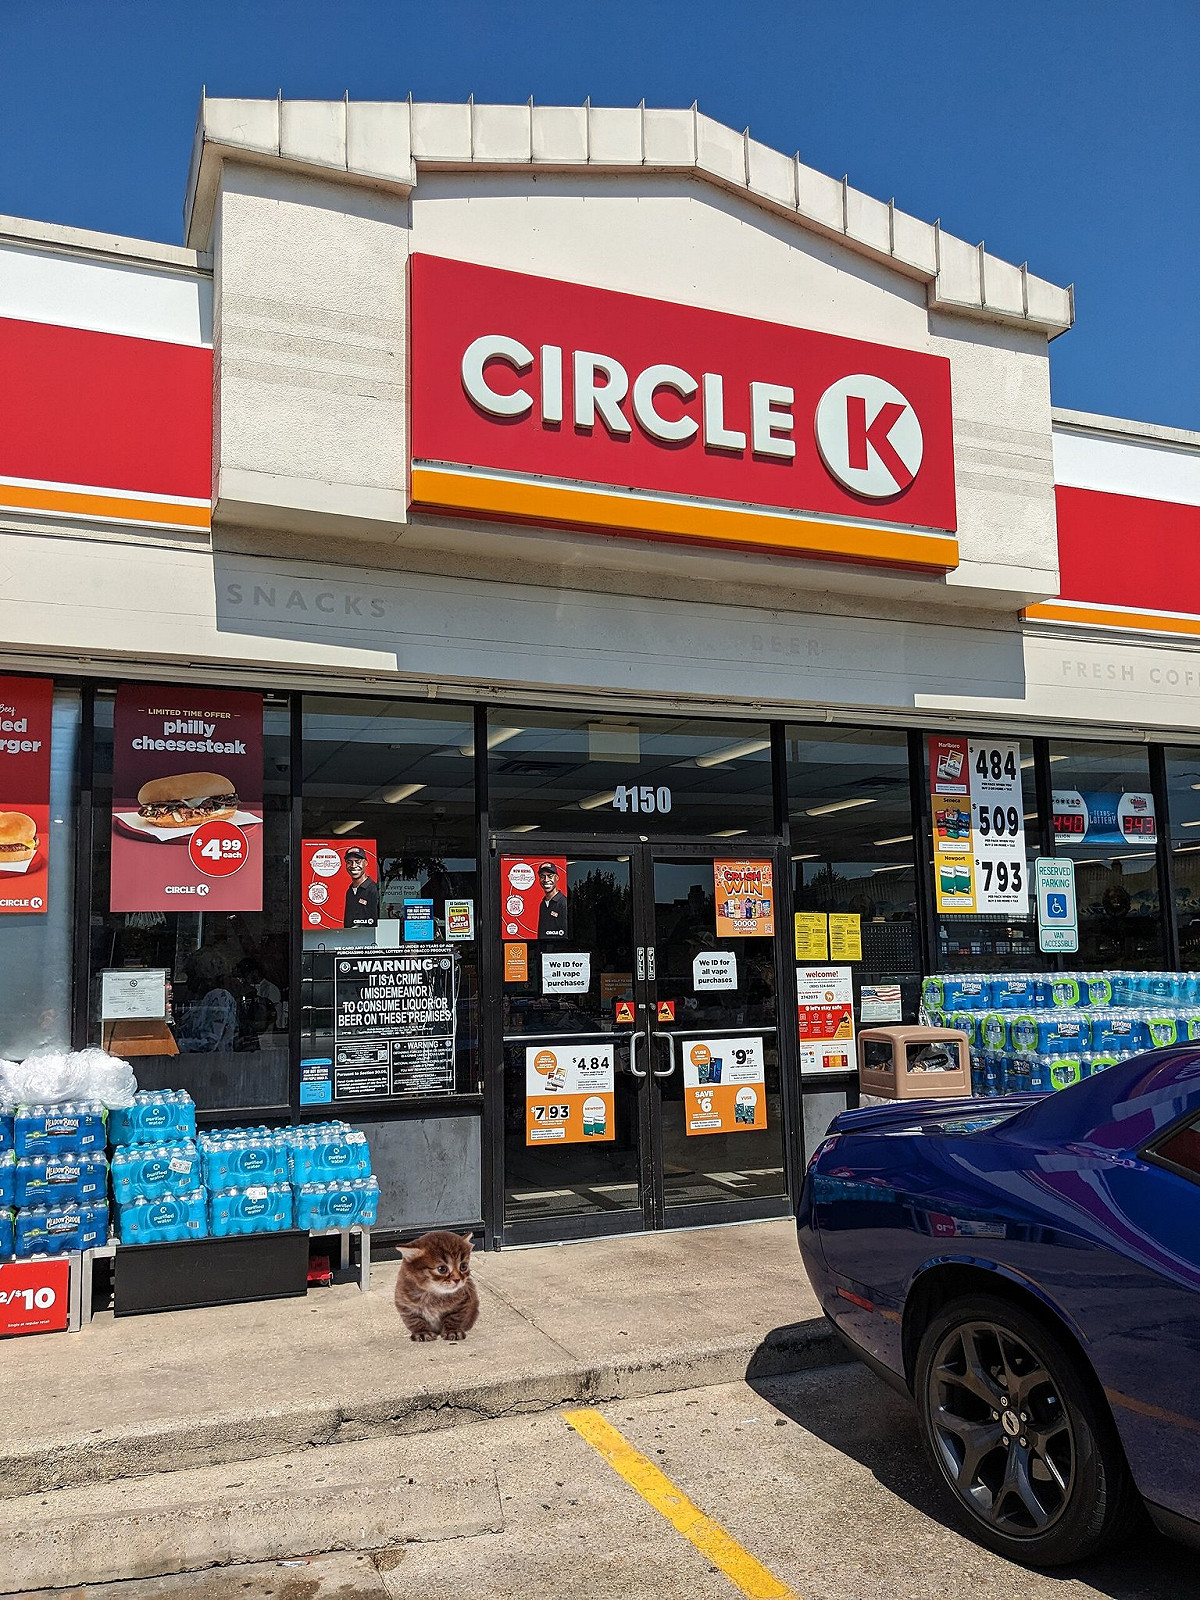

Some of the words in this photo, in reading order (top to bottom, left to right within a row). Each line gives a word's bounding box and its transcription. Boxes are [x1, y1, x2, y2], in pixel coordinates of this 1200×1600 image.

[461, 334, 796, 459] CIRCLE
[845, 395, 915, 492] K
[226, 583, 387, 618] SNACKS
[1061, 660, 1135, 681] FRESH
[148, 708, 182, 716] LIMITED
[182, 709, 203, 718] TIME
[203, 711, 231, 719] OFFER
[163, 719, 216, 738] philly
[131, 735, 247, 755] cheesesteak
[612, 785, 672, 814] 4150
[1089, 815, 1117, 825] LOTTERY
[1124, 817, 1154, 834] 343
[222, 851, 243, 859] each
[723, 870, 762, 881] CRUSH
[1039, 866, 1071, 876] RESERVED
[723, 880, 763, 897] WIN
[1041, 879, 1070, 888] PARKING
[164, 886, 196, 894] CIRCLE
[197, 884, 210, 896] K
[0, 899, 29, 907] CIRCLE
[31, 897, 43, 909] K
[450, 920, 469, 928] Card
[1053, 931, 1064, 939] VAN
[1044, 940, 1074, 948] ACCESSIBLE
[549, 960, 561, 968] We
[571, 960, 584, 968] for
[719, 958, 730, 966] for
[711, 969, 728, 977] vape
[805, 970, 839, 978] welcome!
[369, 974, 378, 986] IT
[379, 974, 387, 986] IS
[388, 974, 395, 985] A
[396, 973, 423, 985] CRIME
[547, 980, 585, 988] purchases
[698, 976, 733, 985] purchases
[343, 1001, 356, 1013] TO
[356, 1000, 401, 1013] CONSUME
[401, 998, 433, 1011] LIQUOR
[435, 997, 448, 1009] OR
[338, 1013, 363, 1027] BEER
[363, 1012, 378, 1025] ON
[380, 1012, 407, 1024] THESE
[694, 1090, 714, 1098] SAVE
[154, 1213, 175, 1222] purified
[0, 1287, 56, 1310] 2/$10
